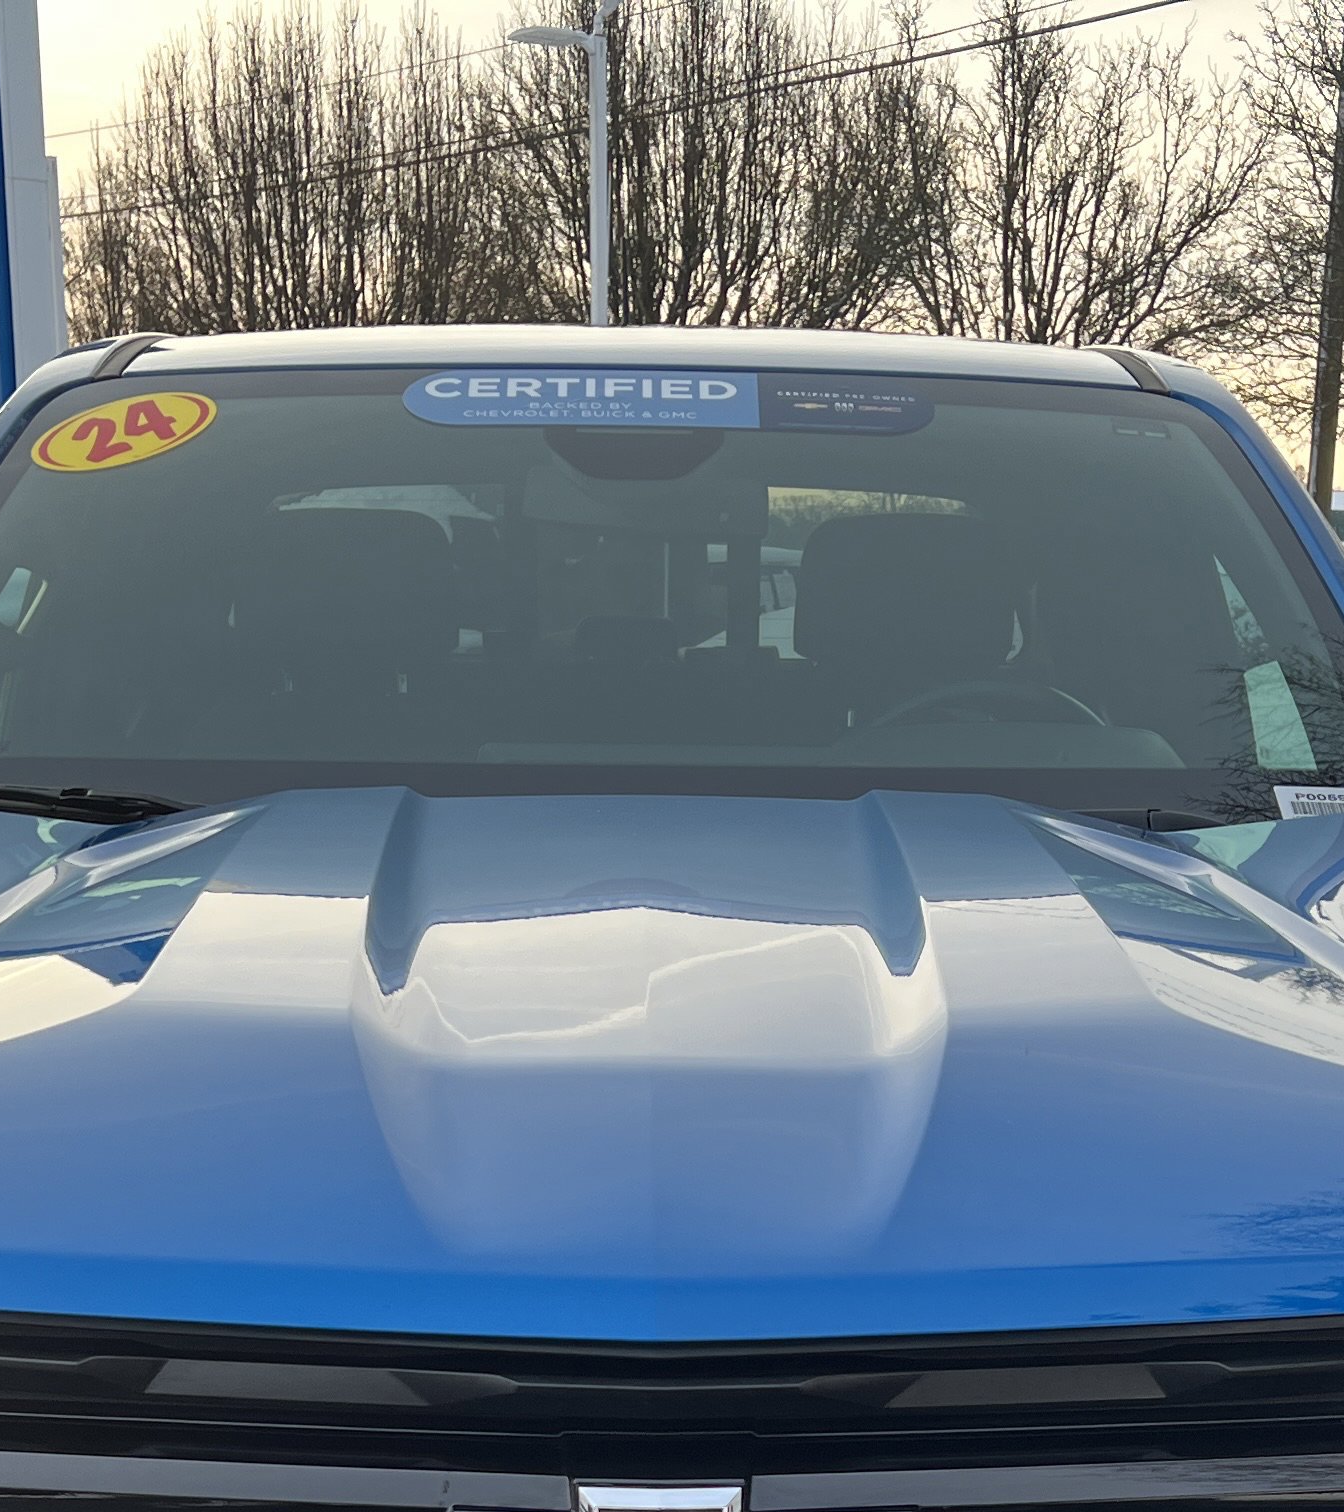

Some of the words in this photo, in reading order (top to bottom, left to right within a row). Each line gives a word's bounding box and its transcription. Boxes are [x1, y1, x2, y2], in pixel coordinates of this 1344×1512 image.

[424, 377, 738, 400] CERTIFIED
[529, 401, 602, 410] BACKED
[609, 402, 632, 410] BY
[581, 410, 636, 418] BUICK
[658, 411, 697, 419] GMC
[71, 399, 177, 463] 24
